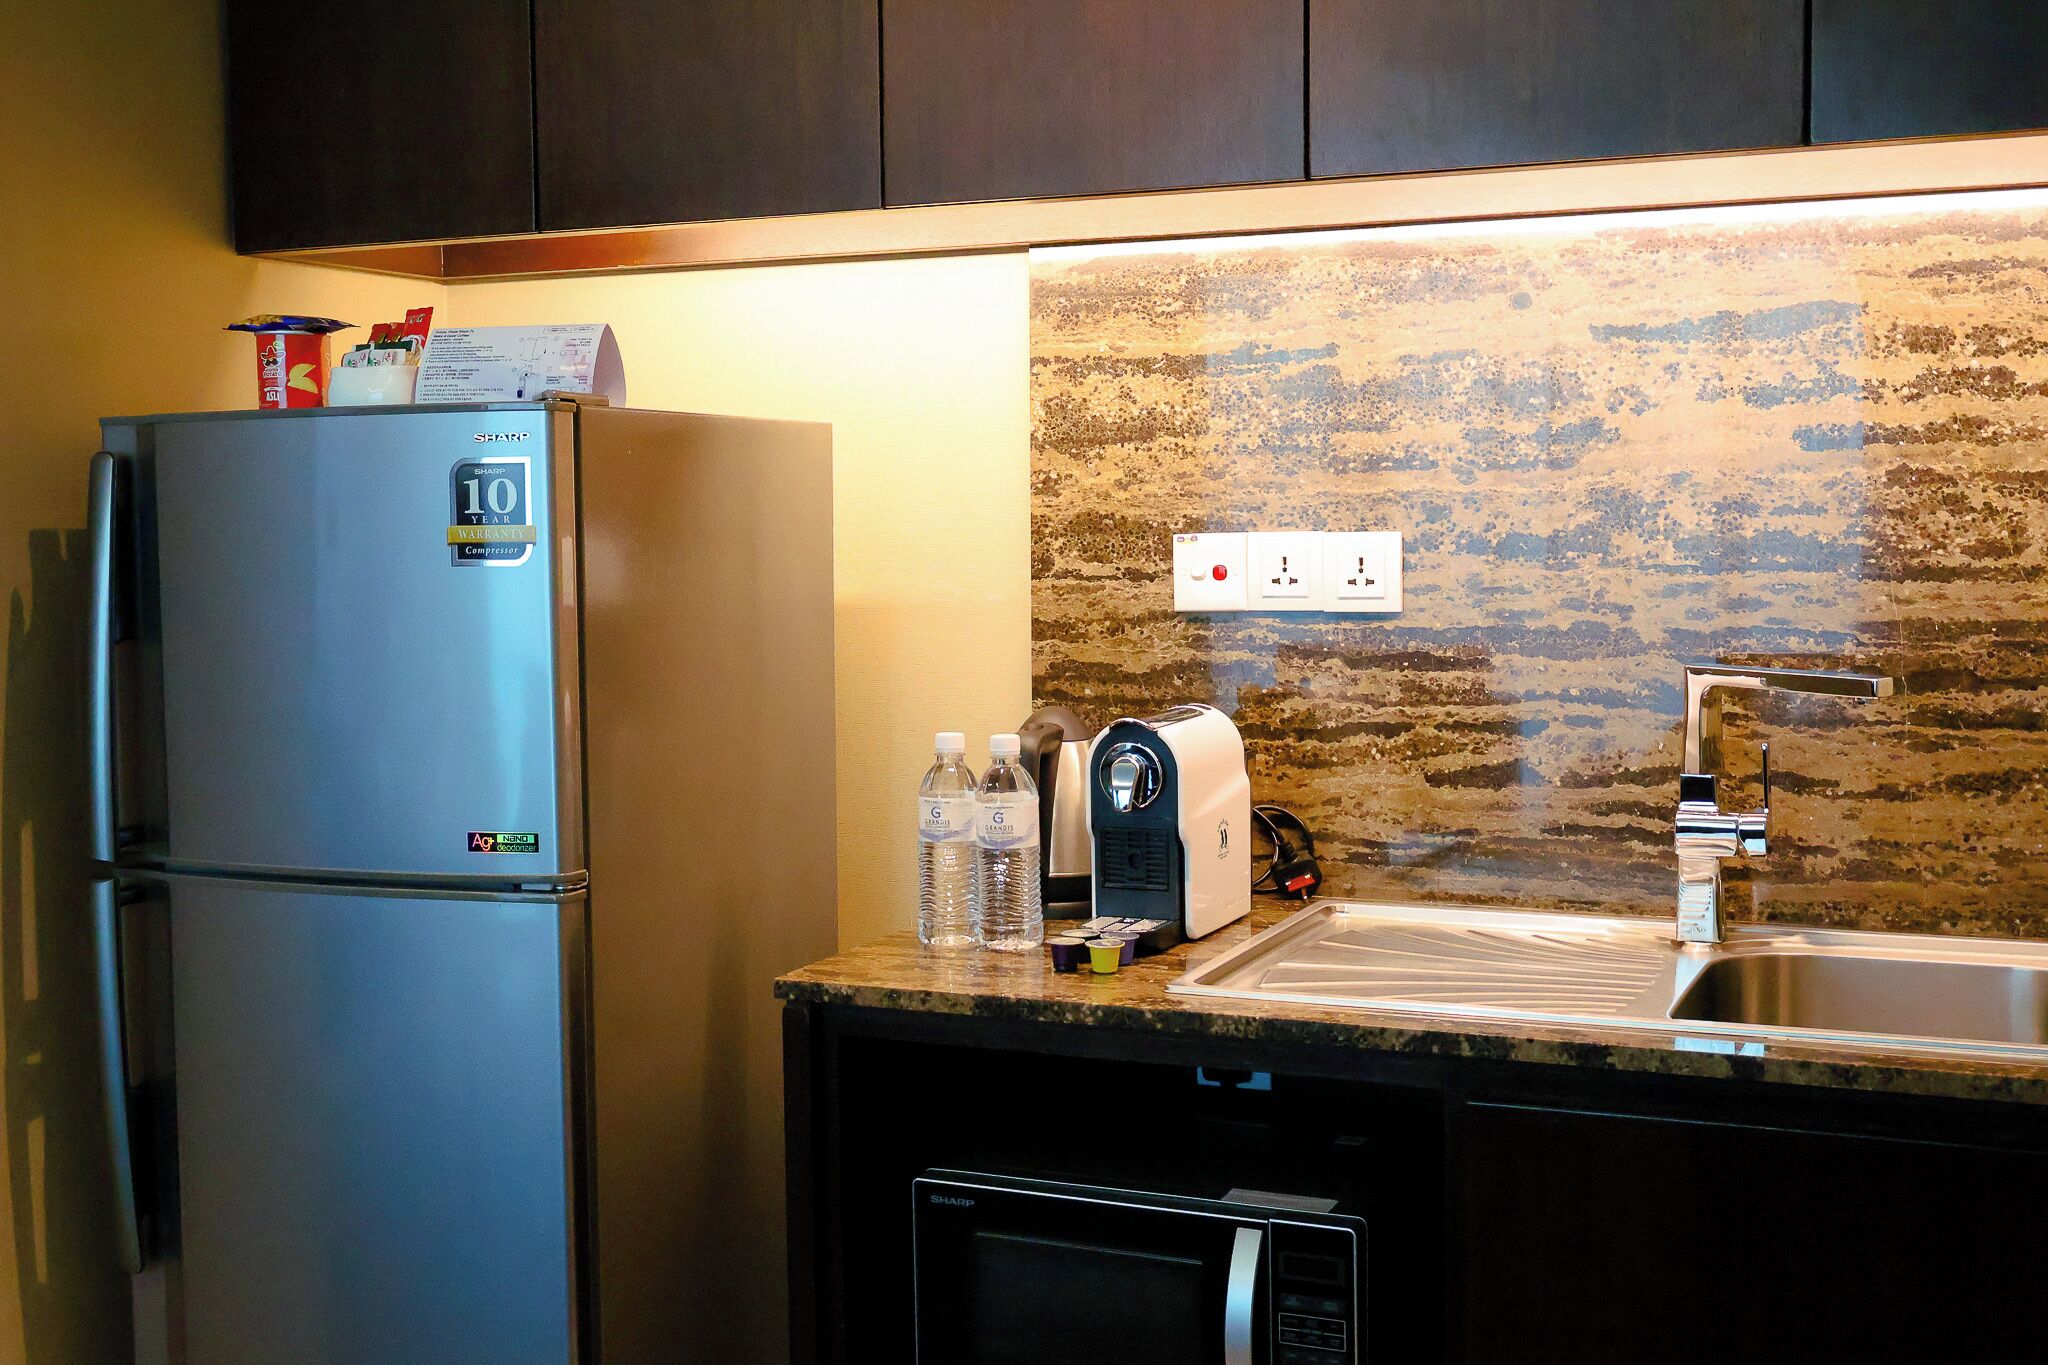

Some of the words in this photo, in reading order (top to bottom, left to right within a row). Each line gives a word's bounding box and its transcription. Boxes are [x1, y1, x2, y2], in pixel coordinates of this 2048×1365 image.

[473, 432, 530, 443] SHARP
[463, 478, 518, 514] 10
[472, 516, 511, 524] YEAR
[458, 529, 526, 539] WARRANTY
[465, 546, 519, 556] Compressor
[496, 843, 537, 852] deodorizer
[930, 1195, 975, 1207] SHARP
